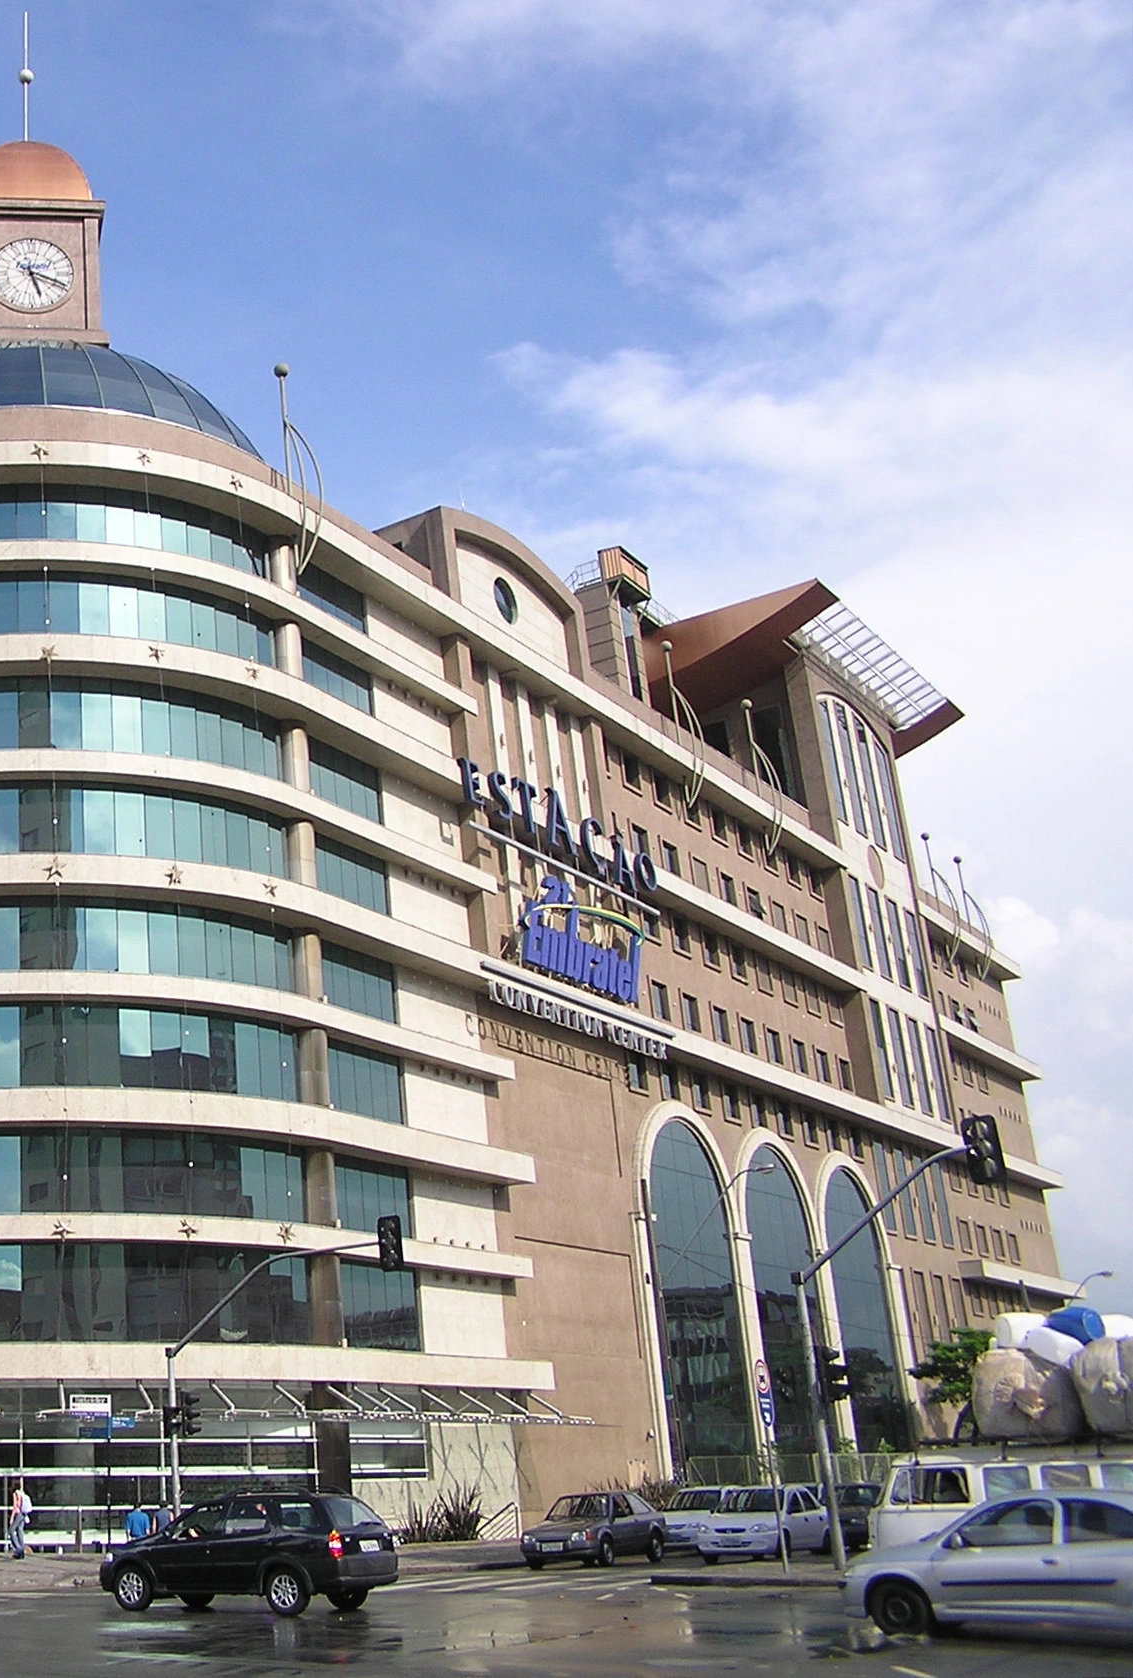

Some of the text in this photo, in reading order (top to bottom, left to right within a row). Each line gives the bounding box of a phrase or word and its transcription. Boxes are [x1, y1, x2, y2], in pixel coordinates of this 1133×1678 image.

[457, 756, 658, 893] ESTAÇÃO
[522, 900, 642, 1003] Embratel
[487, 979, 668, 1061] CONVENTION CENTER
